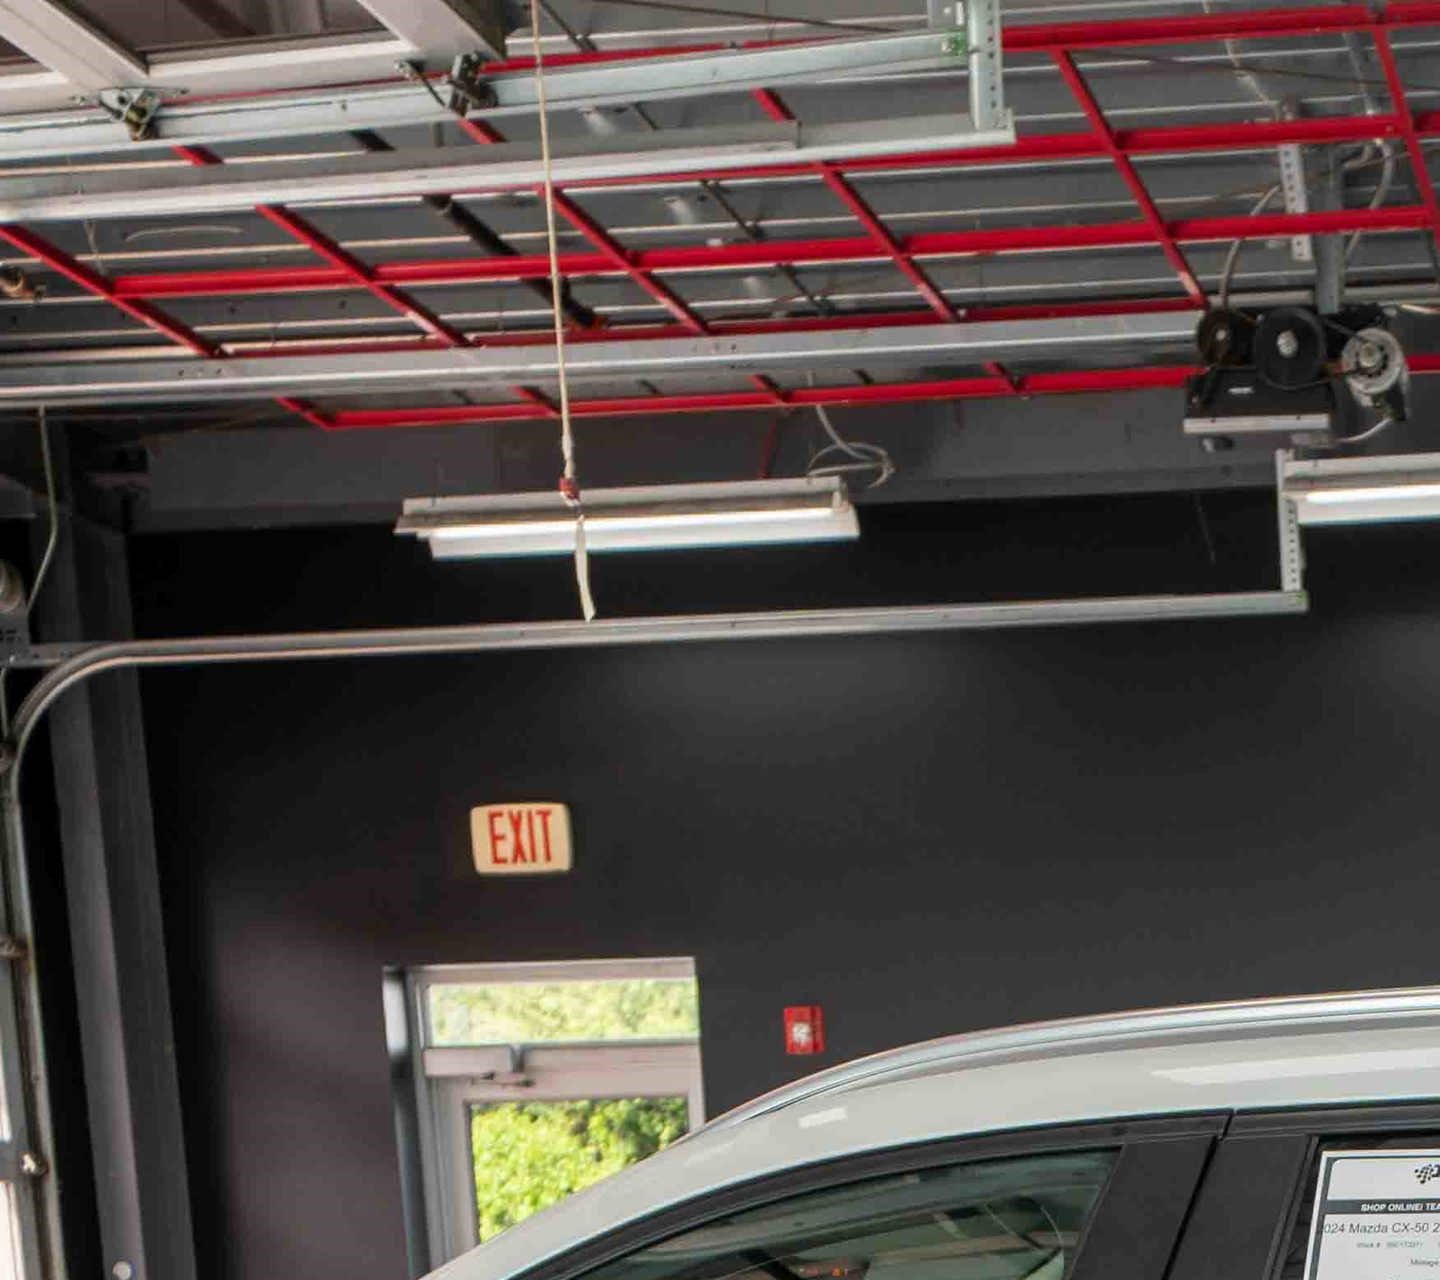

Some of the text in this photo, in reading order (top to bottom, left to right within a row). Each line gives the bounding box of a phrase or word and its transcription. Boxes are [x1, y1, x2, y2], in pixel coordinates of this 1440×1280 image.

[488, 809, 552, 864] EXIT
[1361, 1203, 1385, 1212] SHOP
[1349, 1222, 1388, 1234] Mazda
[1392, 1221, 1429, 1233] CX-50
